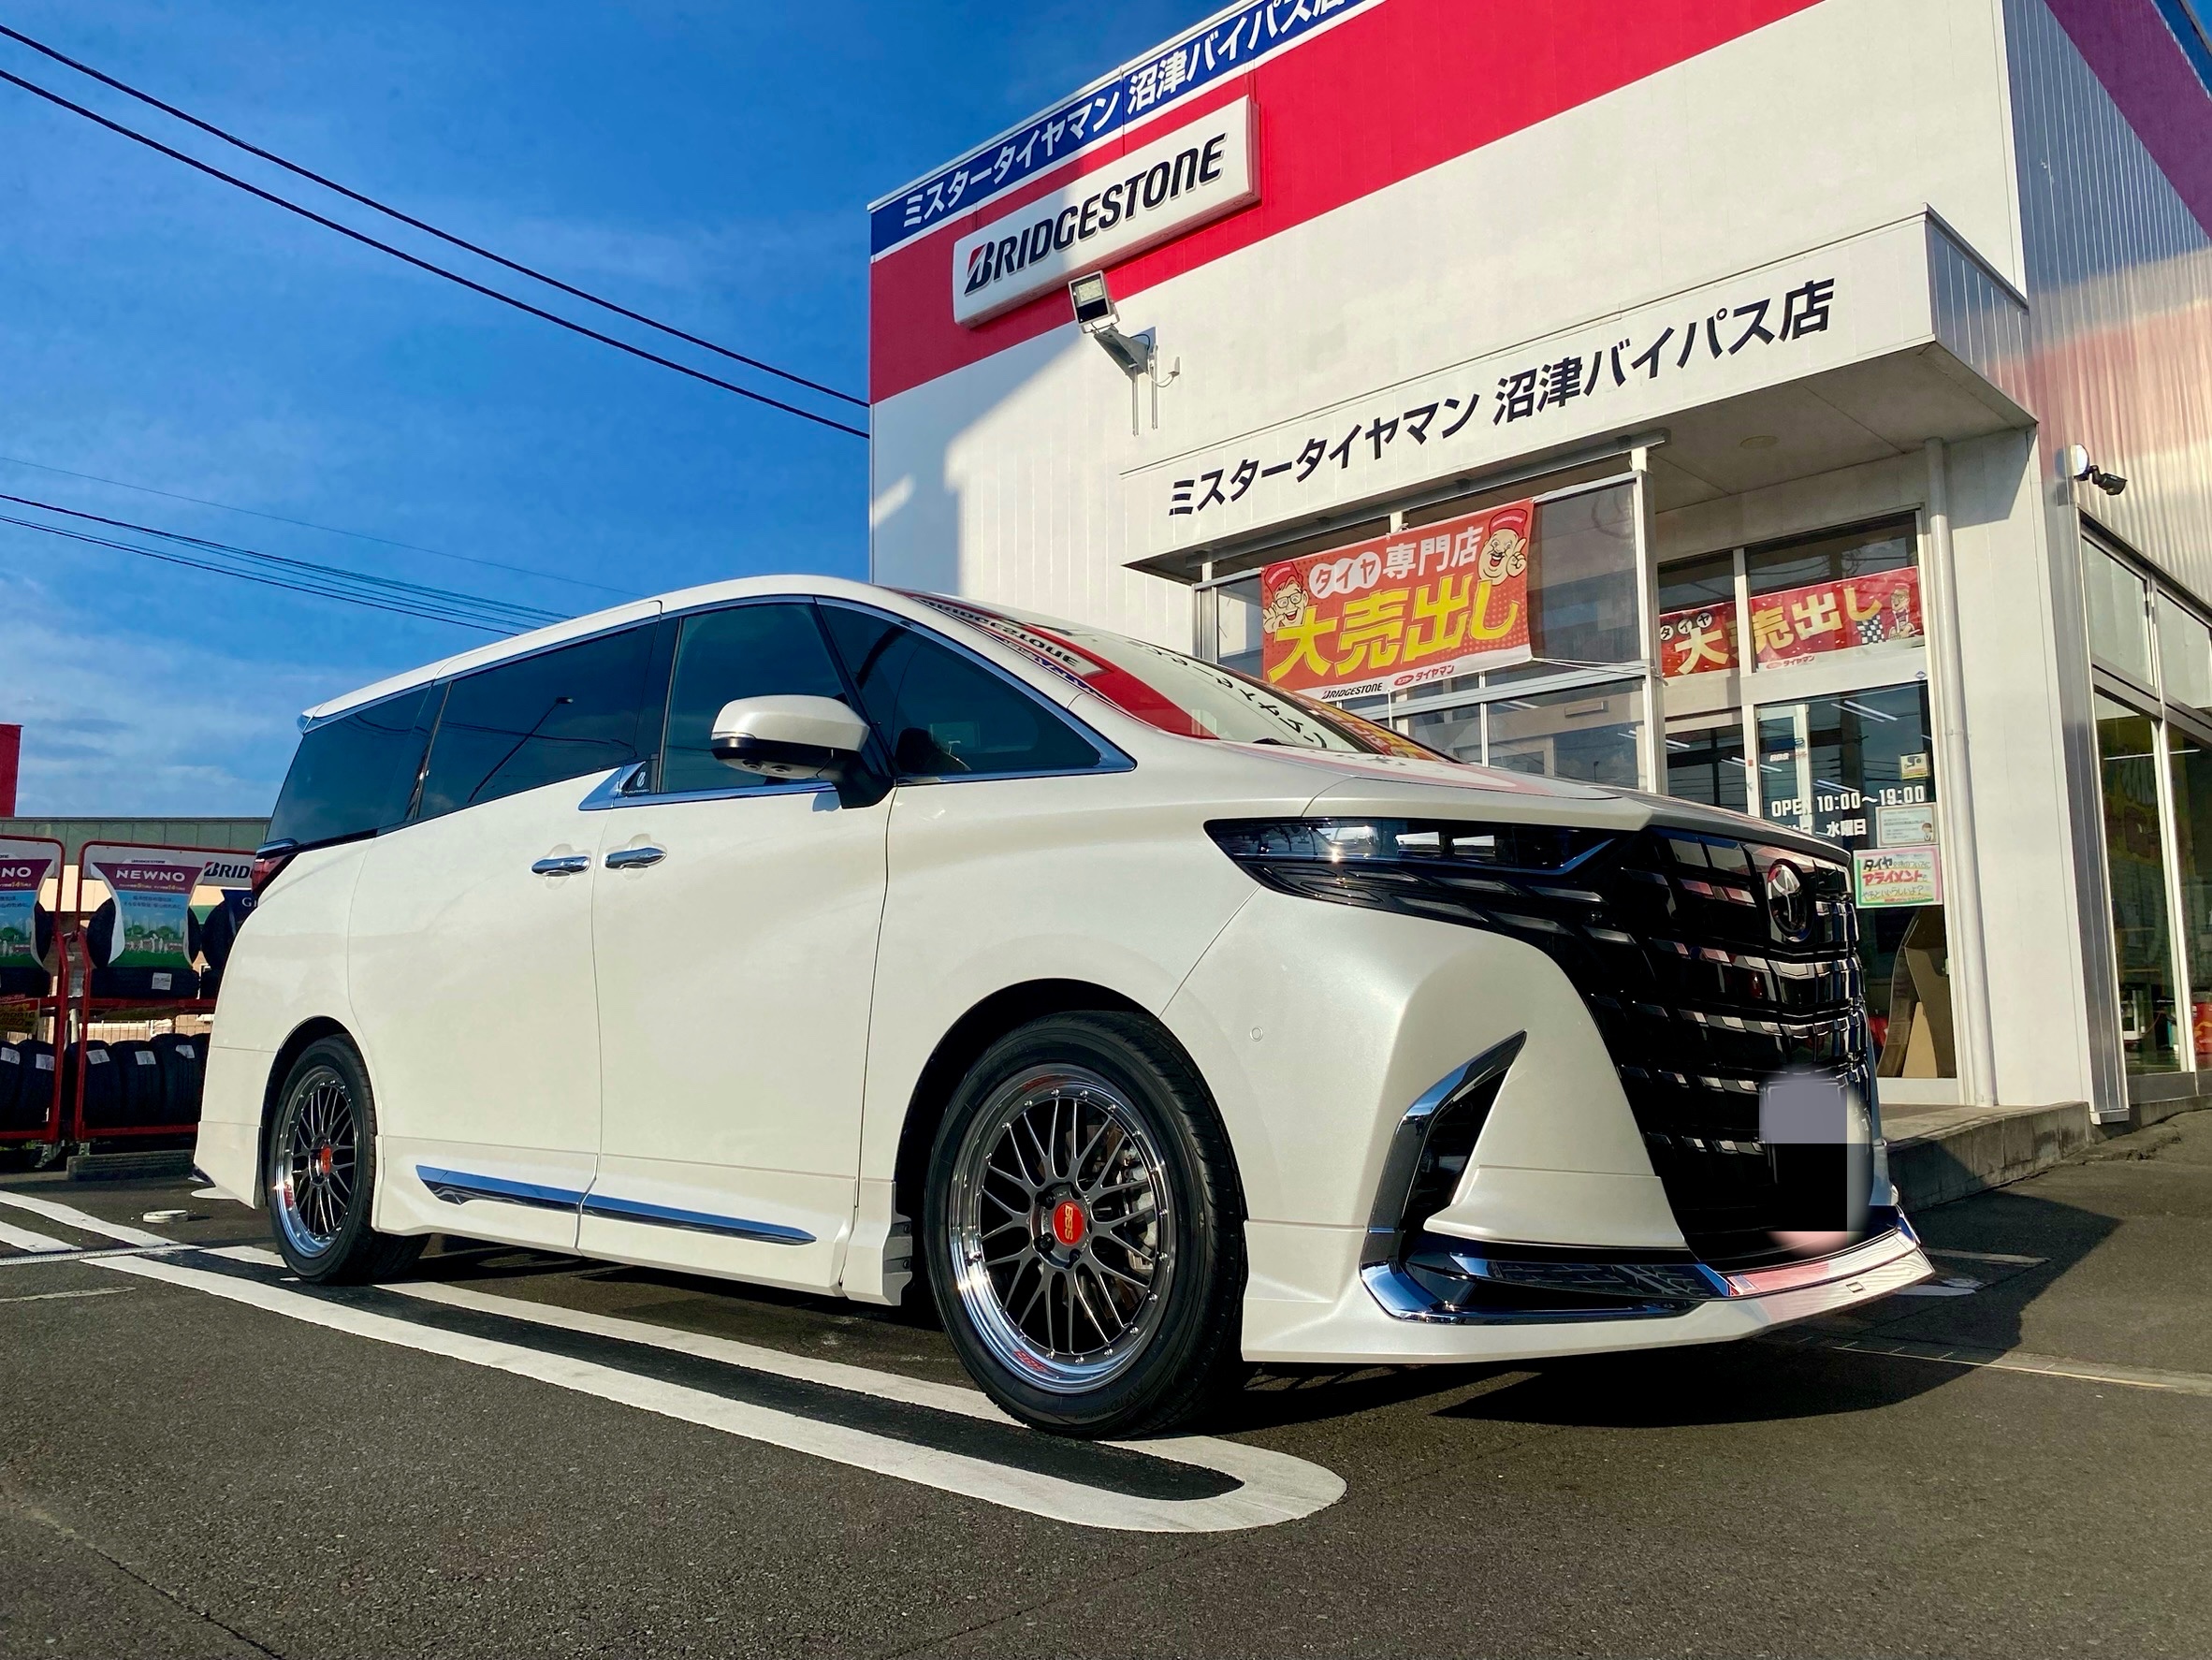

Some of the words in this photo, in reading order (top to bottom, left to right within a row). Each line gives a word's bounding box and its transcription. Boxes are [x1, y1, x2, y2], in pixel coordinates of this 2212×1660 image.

[903, 91, 1121, 227] ミスタータイヤマン
[964, 133, 1228, 295] BRIDGESTONE
[1169, 393, 1480, 517] ミスタータイヤマン
[1493, 278, 1836, 427] 沼津バイパス店
[1315, 526, 1484, 593] タイヤ専門店
[1267, 574, 1521, 684] 大売出し
[1661, 613, 1712, 641] タイヤ
[1674, 586, 1883, 676] 大売出し
[1415, 665, 1455, 681] タイヤマン
[1321, 682, 1383, 700] BRIDGESTONE
[1771, 798, 1812, 817] OPEN
[1826, 818, 1867, 838] 水曜日
[116, 869, 186, 882] NEWNO
[204, 861, 254, 879] BRID
[1065, 1204, 1074, 1241] BBS
